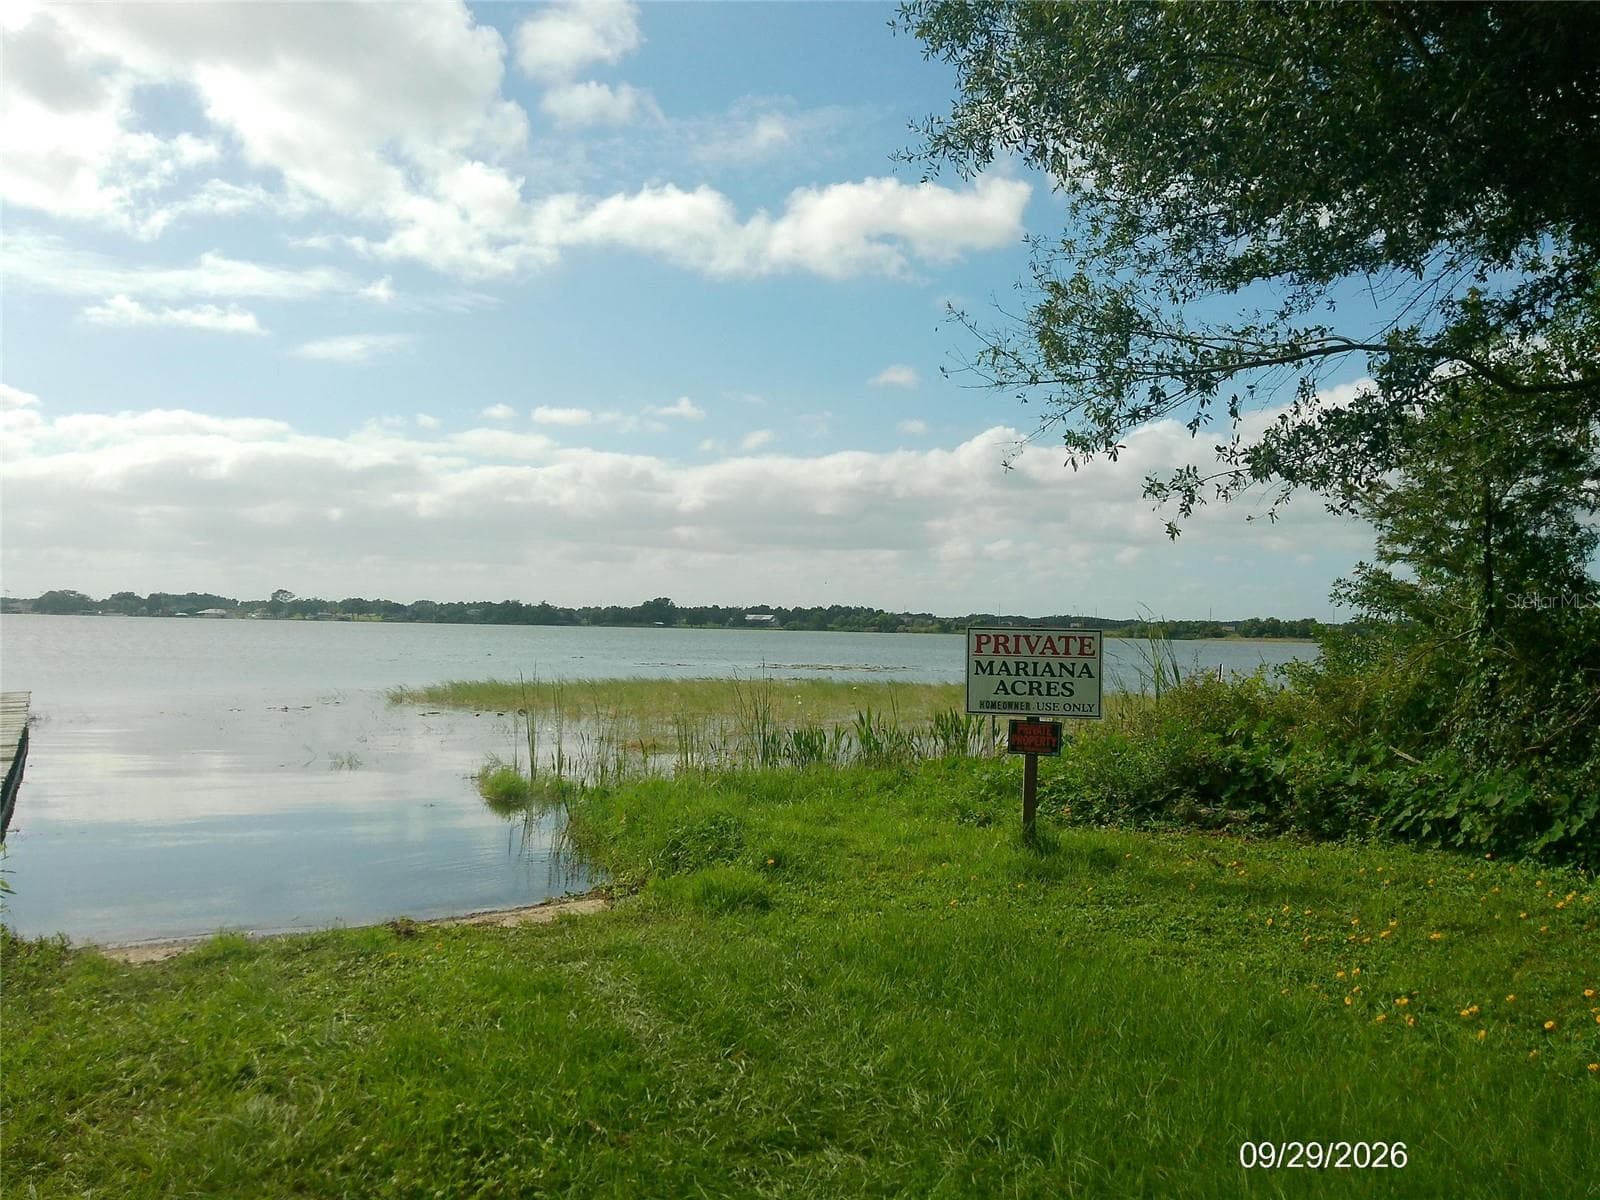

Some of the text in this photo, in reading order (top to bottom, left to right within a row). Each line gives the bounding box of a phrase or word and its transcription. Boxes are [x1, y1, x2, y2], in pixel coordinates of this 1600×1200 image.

[974, 633, 1096, 657] PRIVATE
[974, 659, 1096, 679] MARIANA
[993, 679, 1075, 698] ACRES
[979, 700, 1095, 713] HOMEOWNER USE ONLY
